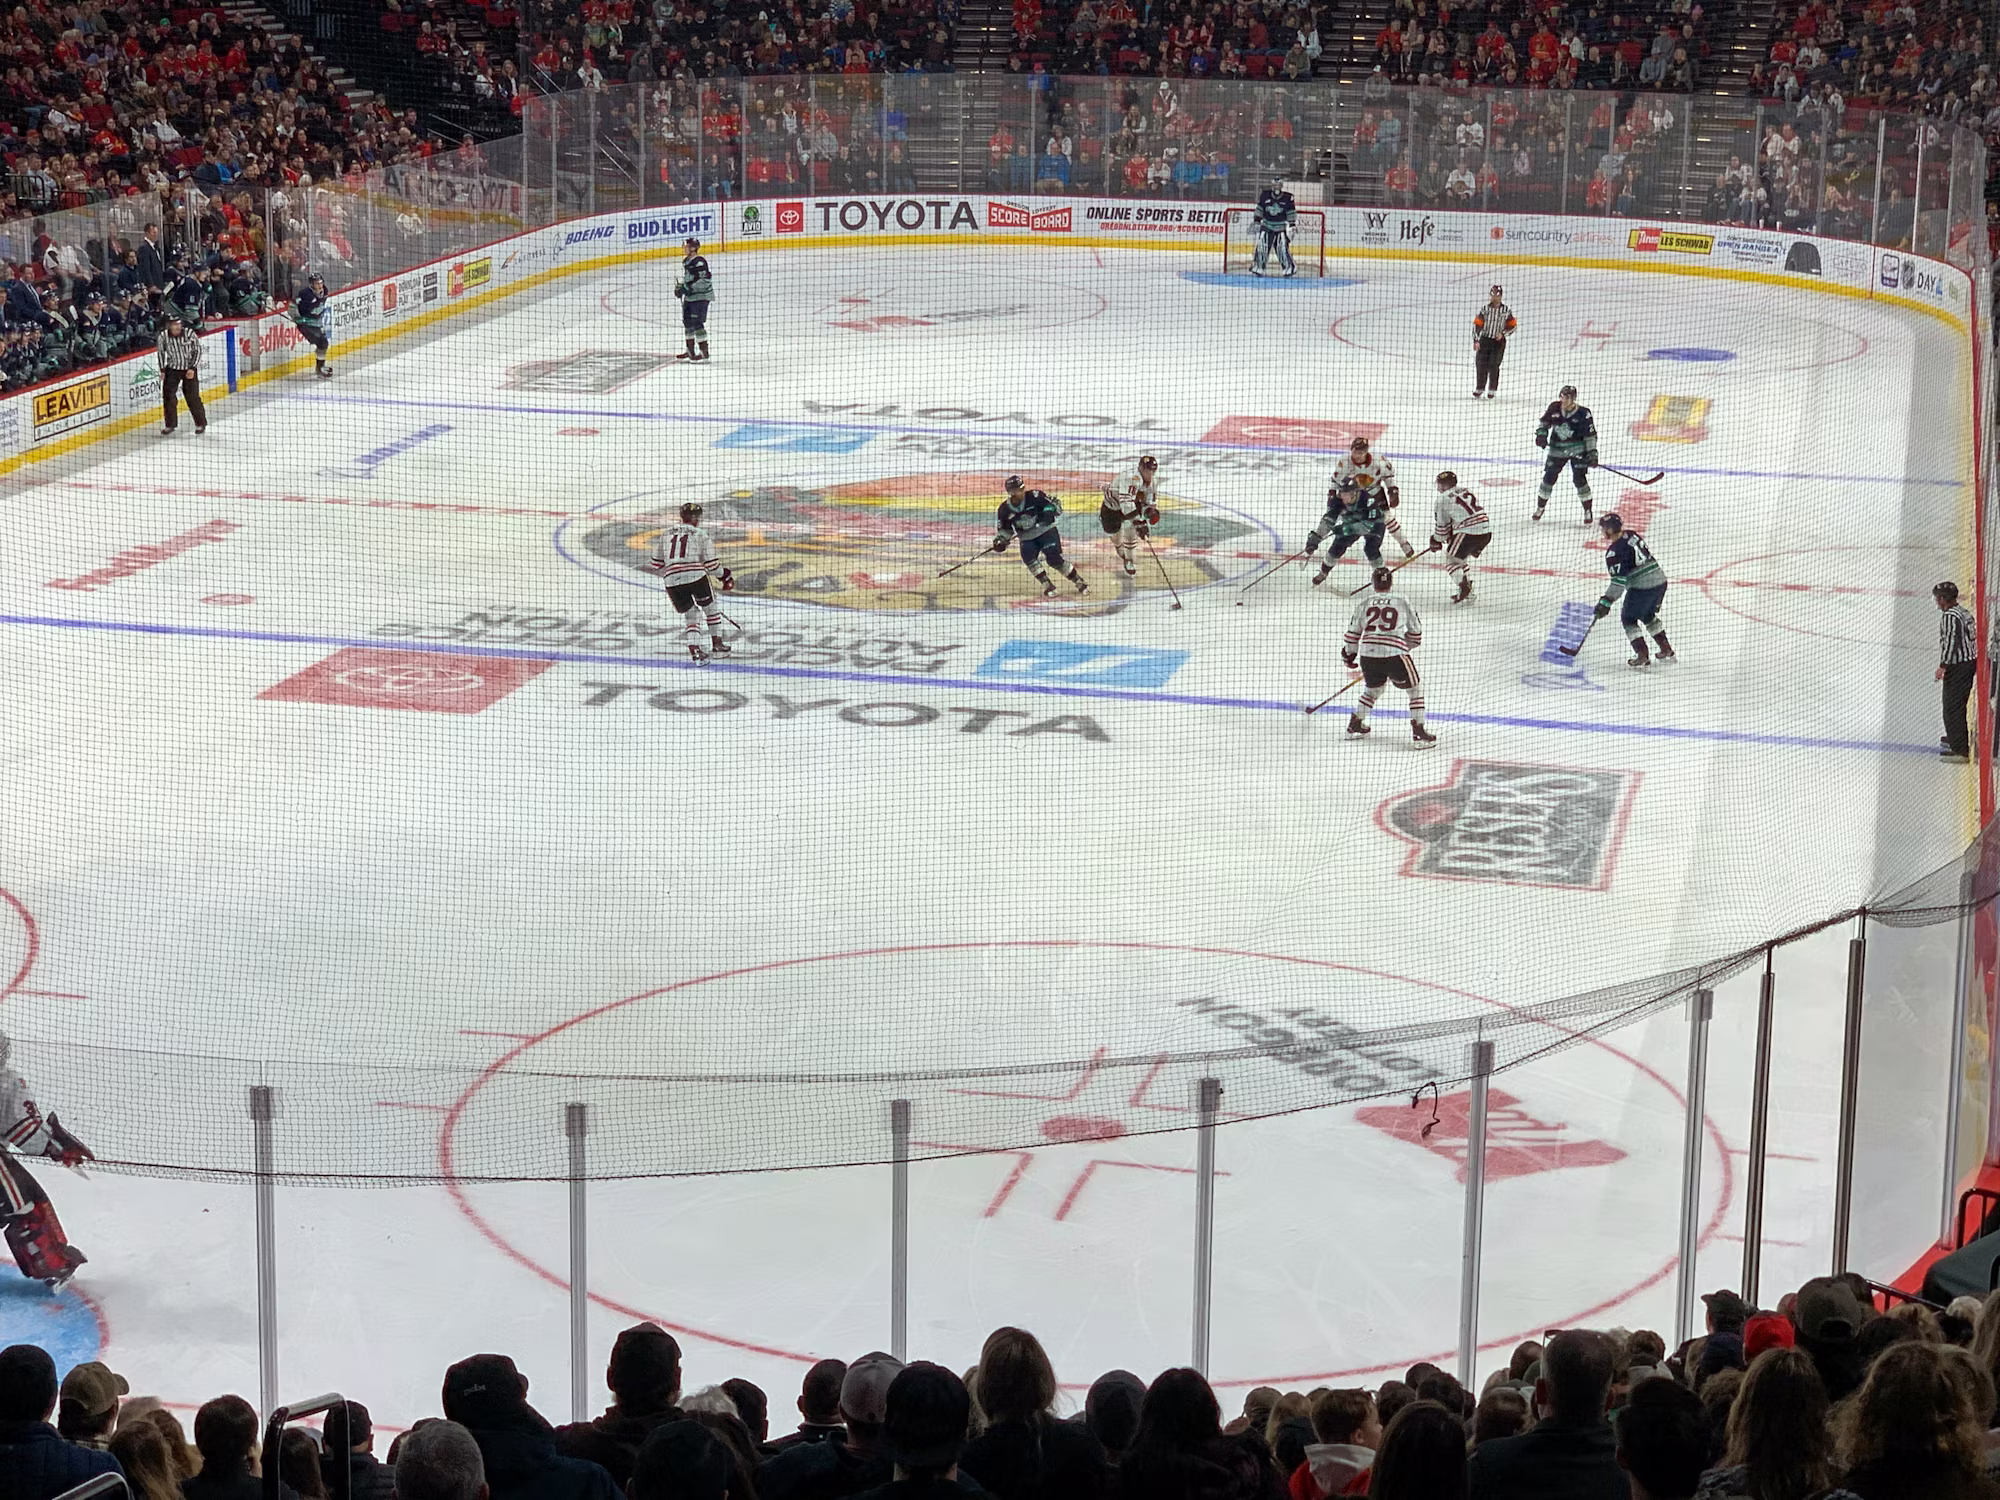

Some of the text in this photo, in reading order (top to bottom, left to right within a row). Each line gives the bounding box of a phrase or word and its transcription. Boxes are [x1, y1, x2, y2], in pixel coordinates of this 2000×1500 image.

[815, 199, 979, 231] TOYOTA
[990, 207, 1028, 225] SCORE
[1006, 200, 1030, 211] OREGON
[1032, 205, 1057, 215] LOTTERY
[1087, 206, 1132, 220] ONLINE
[1136, 208, 1184, 222] SPORTS
[627, 215, 713, 240] BUD LIGHT
[1033, 212, 1069, 229] BOARD
[1400, 215, 1436, 246] Hefe
[564, 225, 615, 246] BOEING
[1660, 236, 1709, 250] LES SCHWAB
[36, 380, 108, 422] LEAVITT
[129, 382, 161, 401] OREGON
[1455, 492, 1484, 516] 12
[669, 534, 689, 560] 11
[1608, 562, 1622, 576] 47
[1364, 606, 1399, 632] 29
[580, 681, 1113, 744] TOYOTA
[1177, 996, 1385, 1094] OREGON
[1272, 1003, 1446, 1082] LOTTERY
